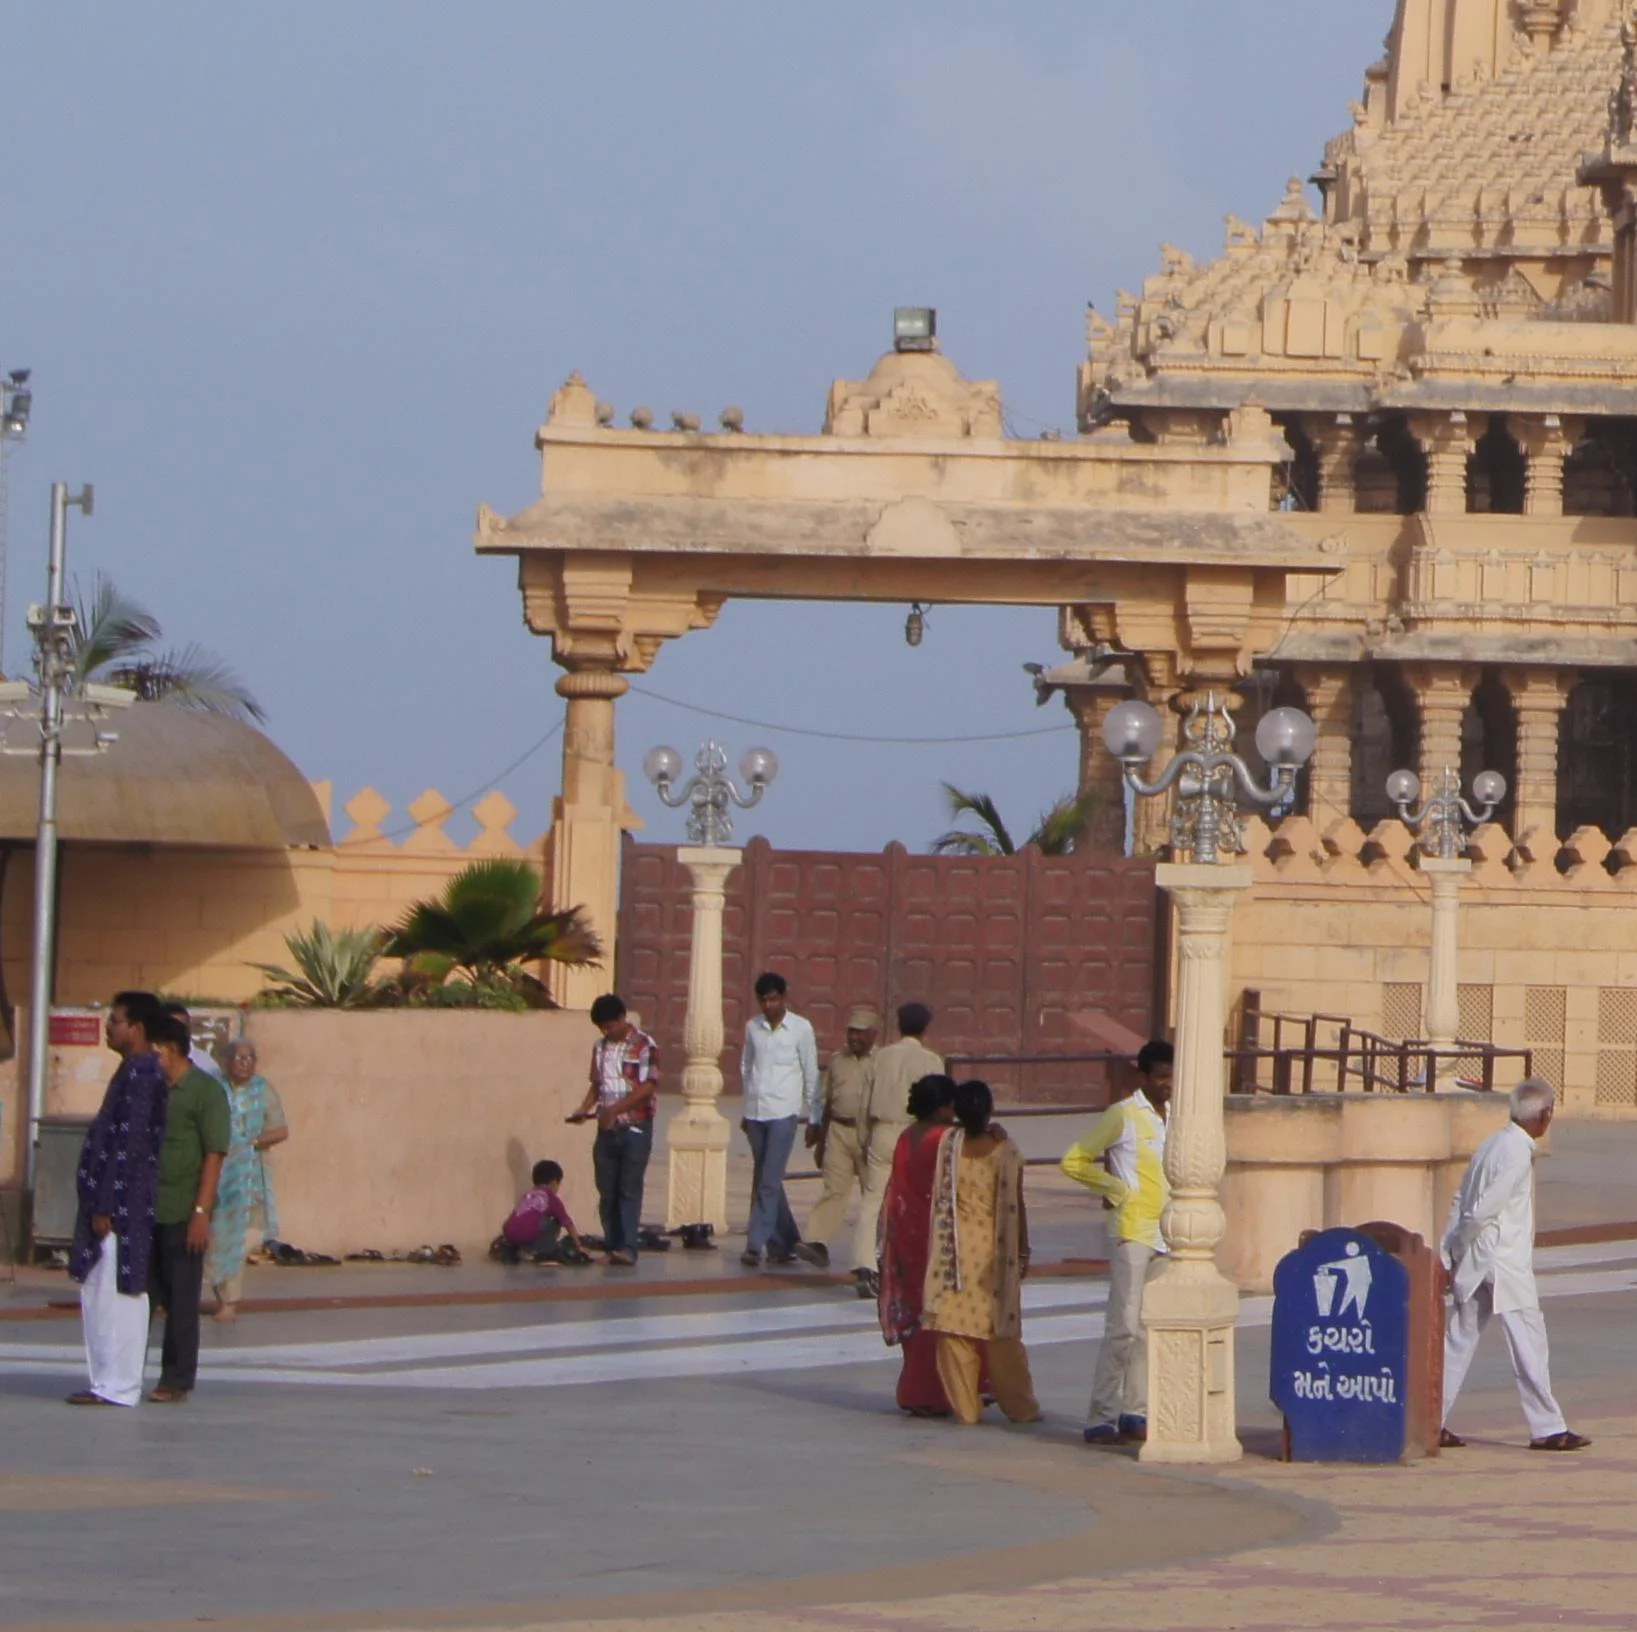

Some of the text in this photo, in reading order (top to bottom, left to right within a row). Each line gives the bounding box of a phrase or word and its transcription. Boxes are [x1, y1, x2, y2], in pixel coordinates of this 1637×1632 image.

[1306, 1319, 1375, 1355] કચરો
[1293, 1361, 1397, 1403] મને આપો
